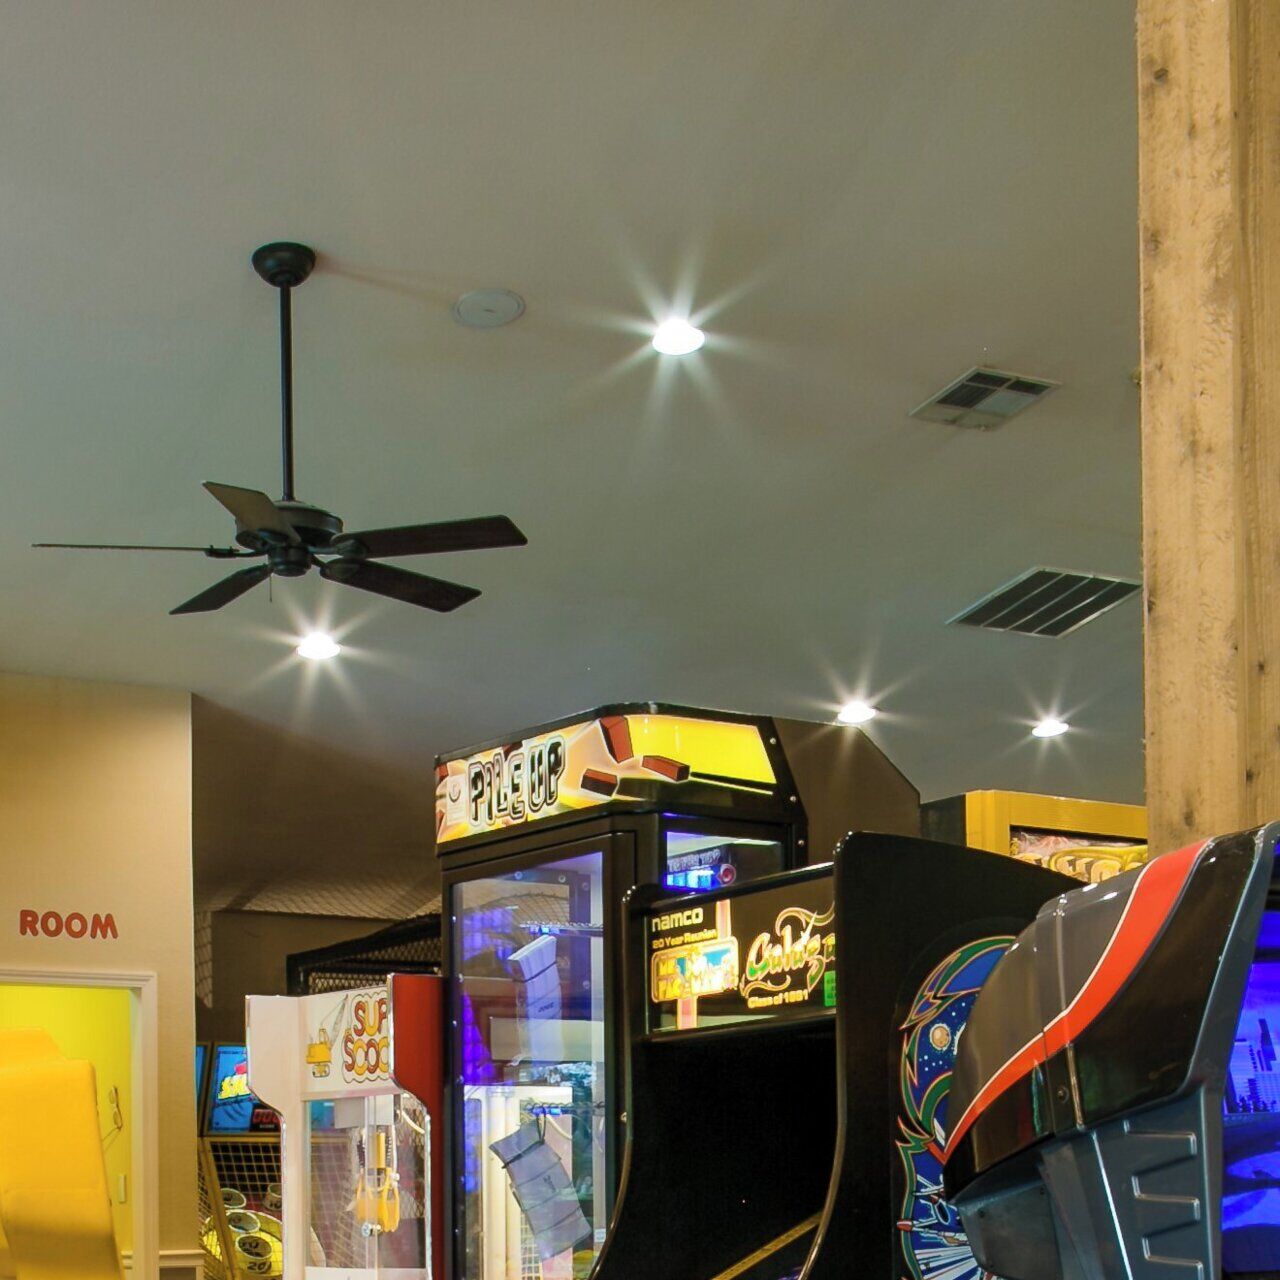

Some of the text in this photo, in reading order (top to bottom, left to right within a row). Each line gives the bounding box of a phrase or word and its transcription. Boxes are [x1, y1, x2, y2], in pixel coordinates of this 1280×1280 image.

[469, 735, 566, 827] PILE UP
[20, 908, 119, 940] ROOM
[651, 907, 704, 933] namco
[353, 997, 388, 1036] SUP
